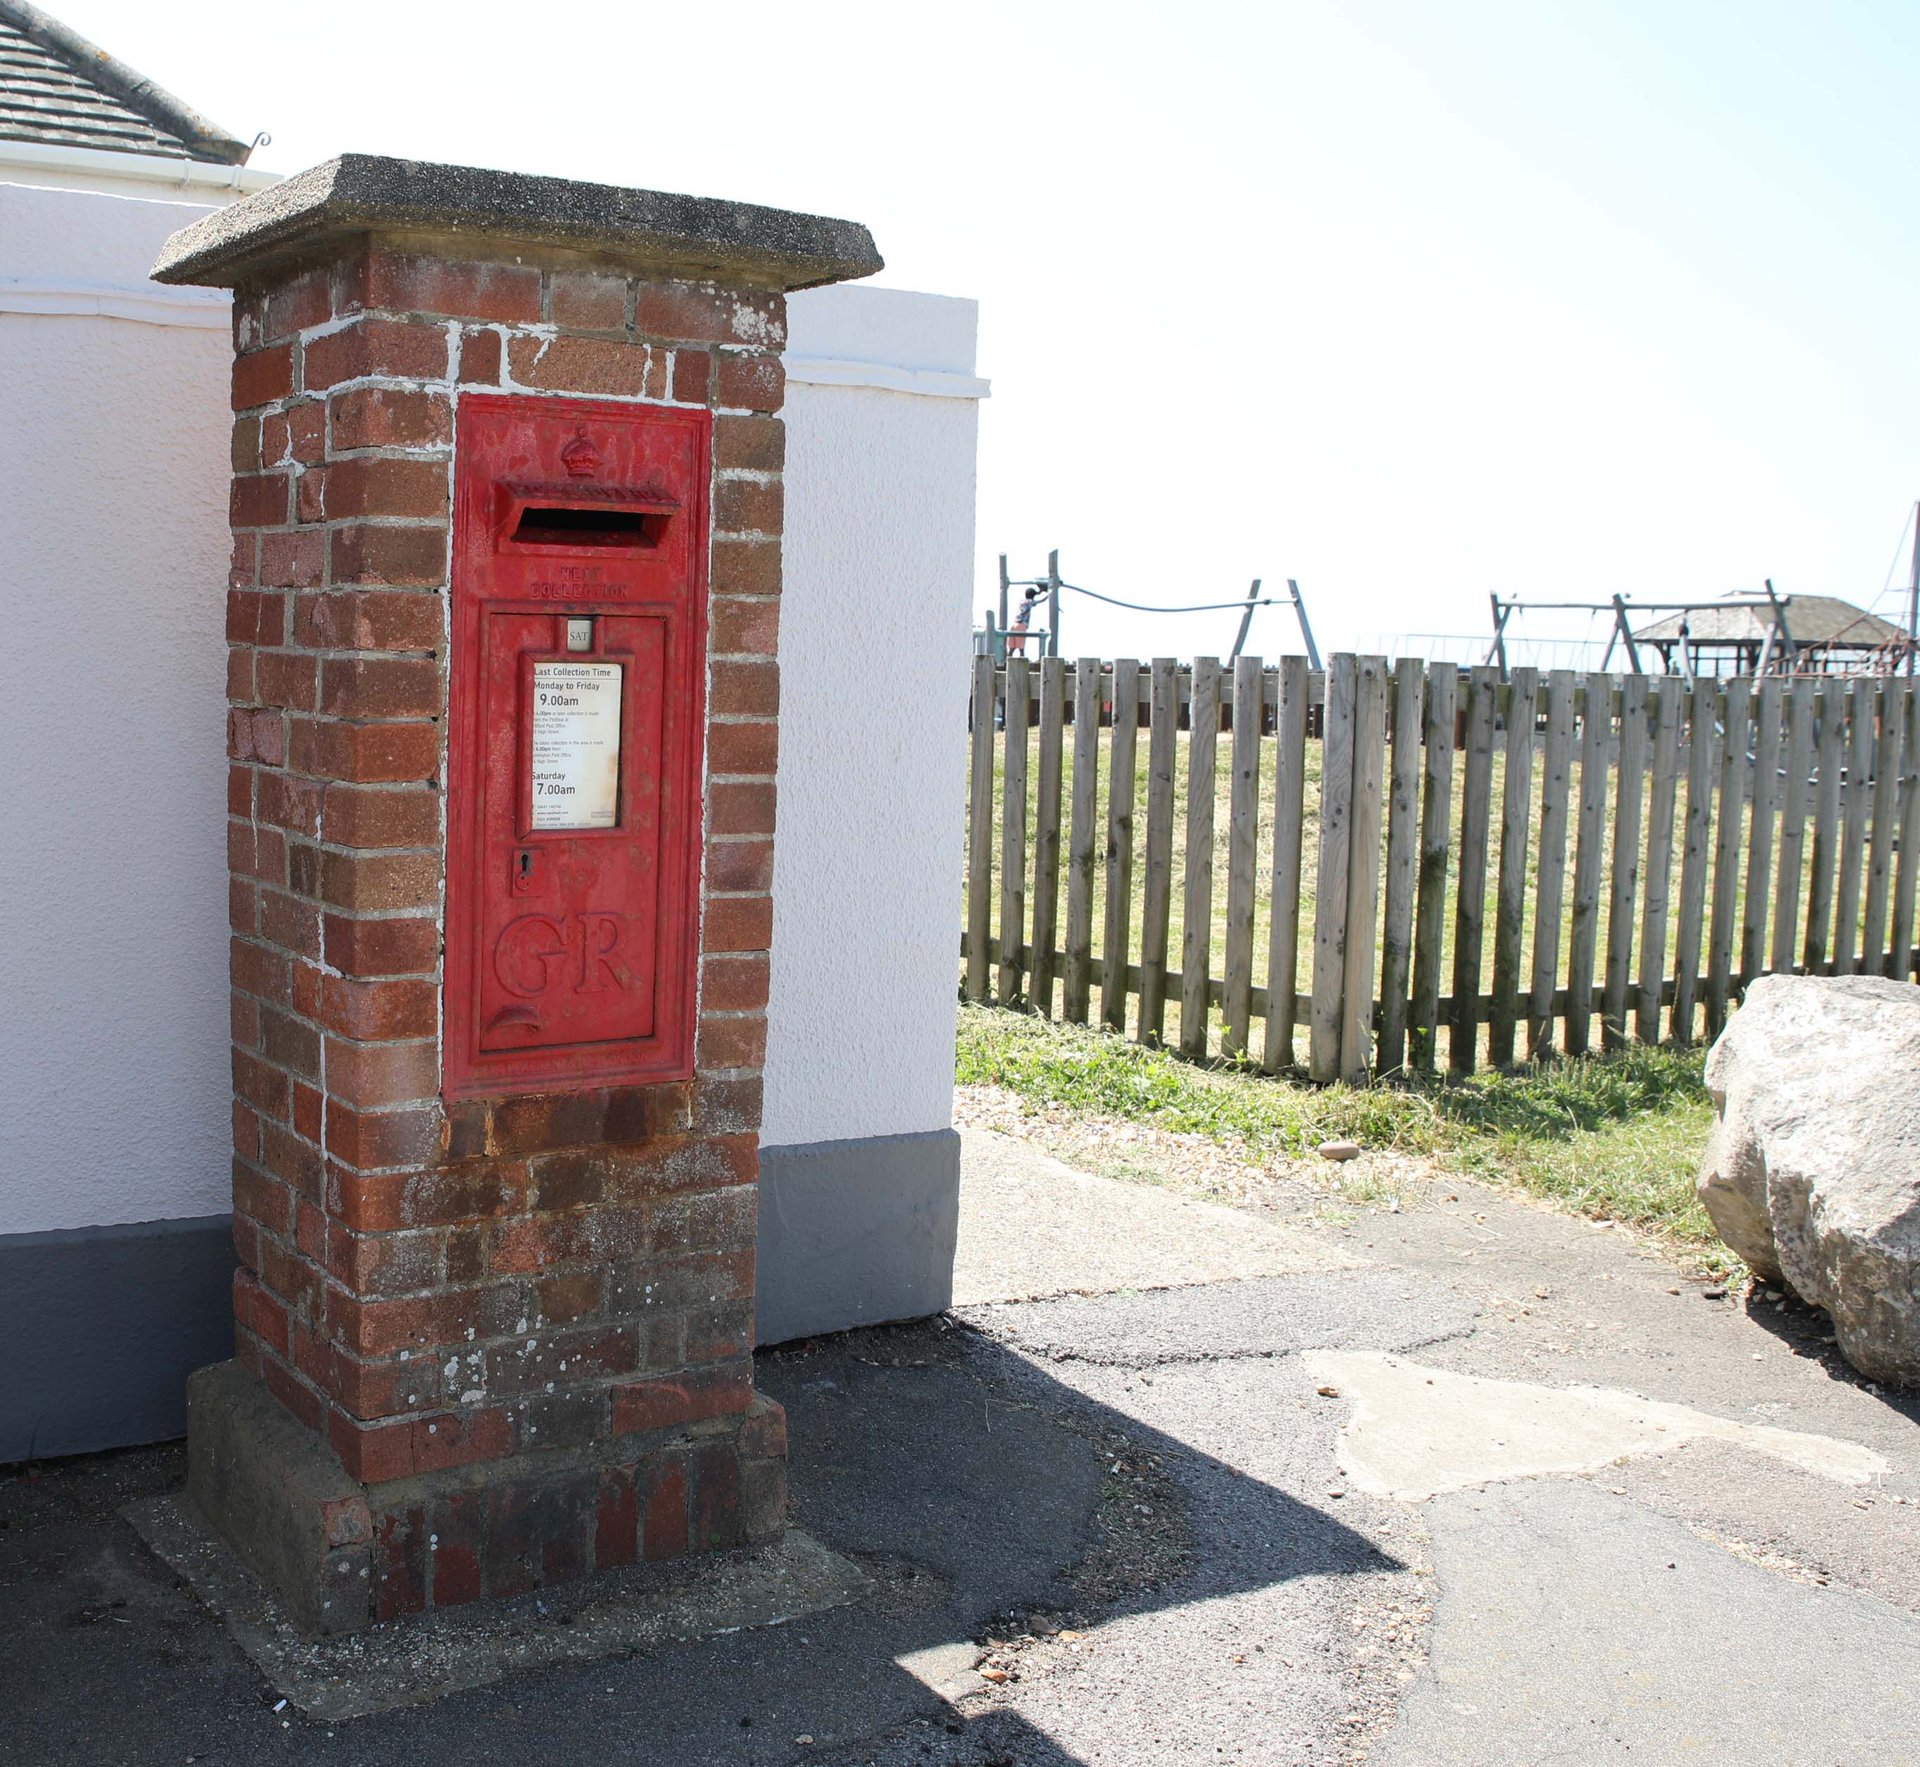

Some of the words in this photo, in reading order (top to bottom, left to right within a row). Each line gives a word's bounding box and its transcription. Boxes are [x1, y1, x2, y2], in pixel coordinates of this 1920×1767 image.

[531, 583, 629, 599] COLLECTION
[570, 631, 588, 641] SAT
[534, 667, 551, 676] Last
[553, 667, 590, 676] Collection
[592, 668, 611, 677] Time
[534, 682, 564, 691] Monday
[566, 682, 574, 690] to
[576, 682, 600, 692] Friday
[540, 693, 579, 706] 9.00am
[531, 771, 566, 781] Saturday
[537, 783, 576, 795] 7.00am
[493, 912, 644, 999] GR
